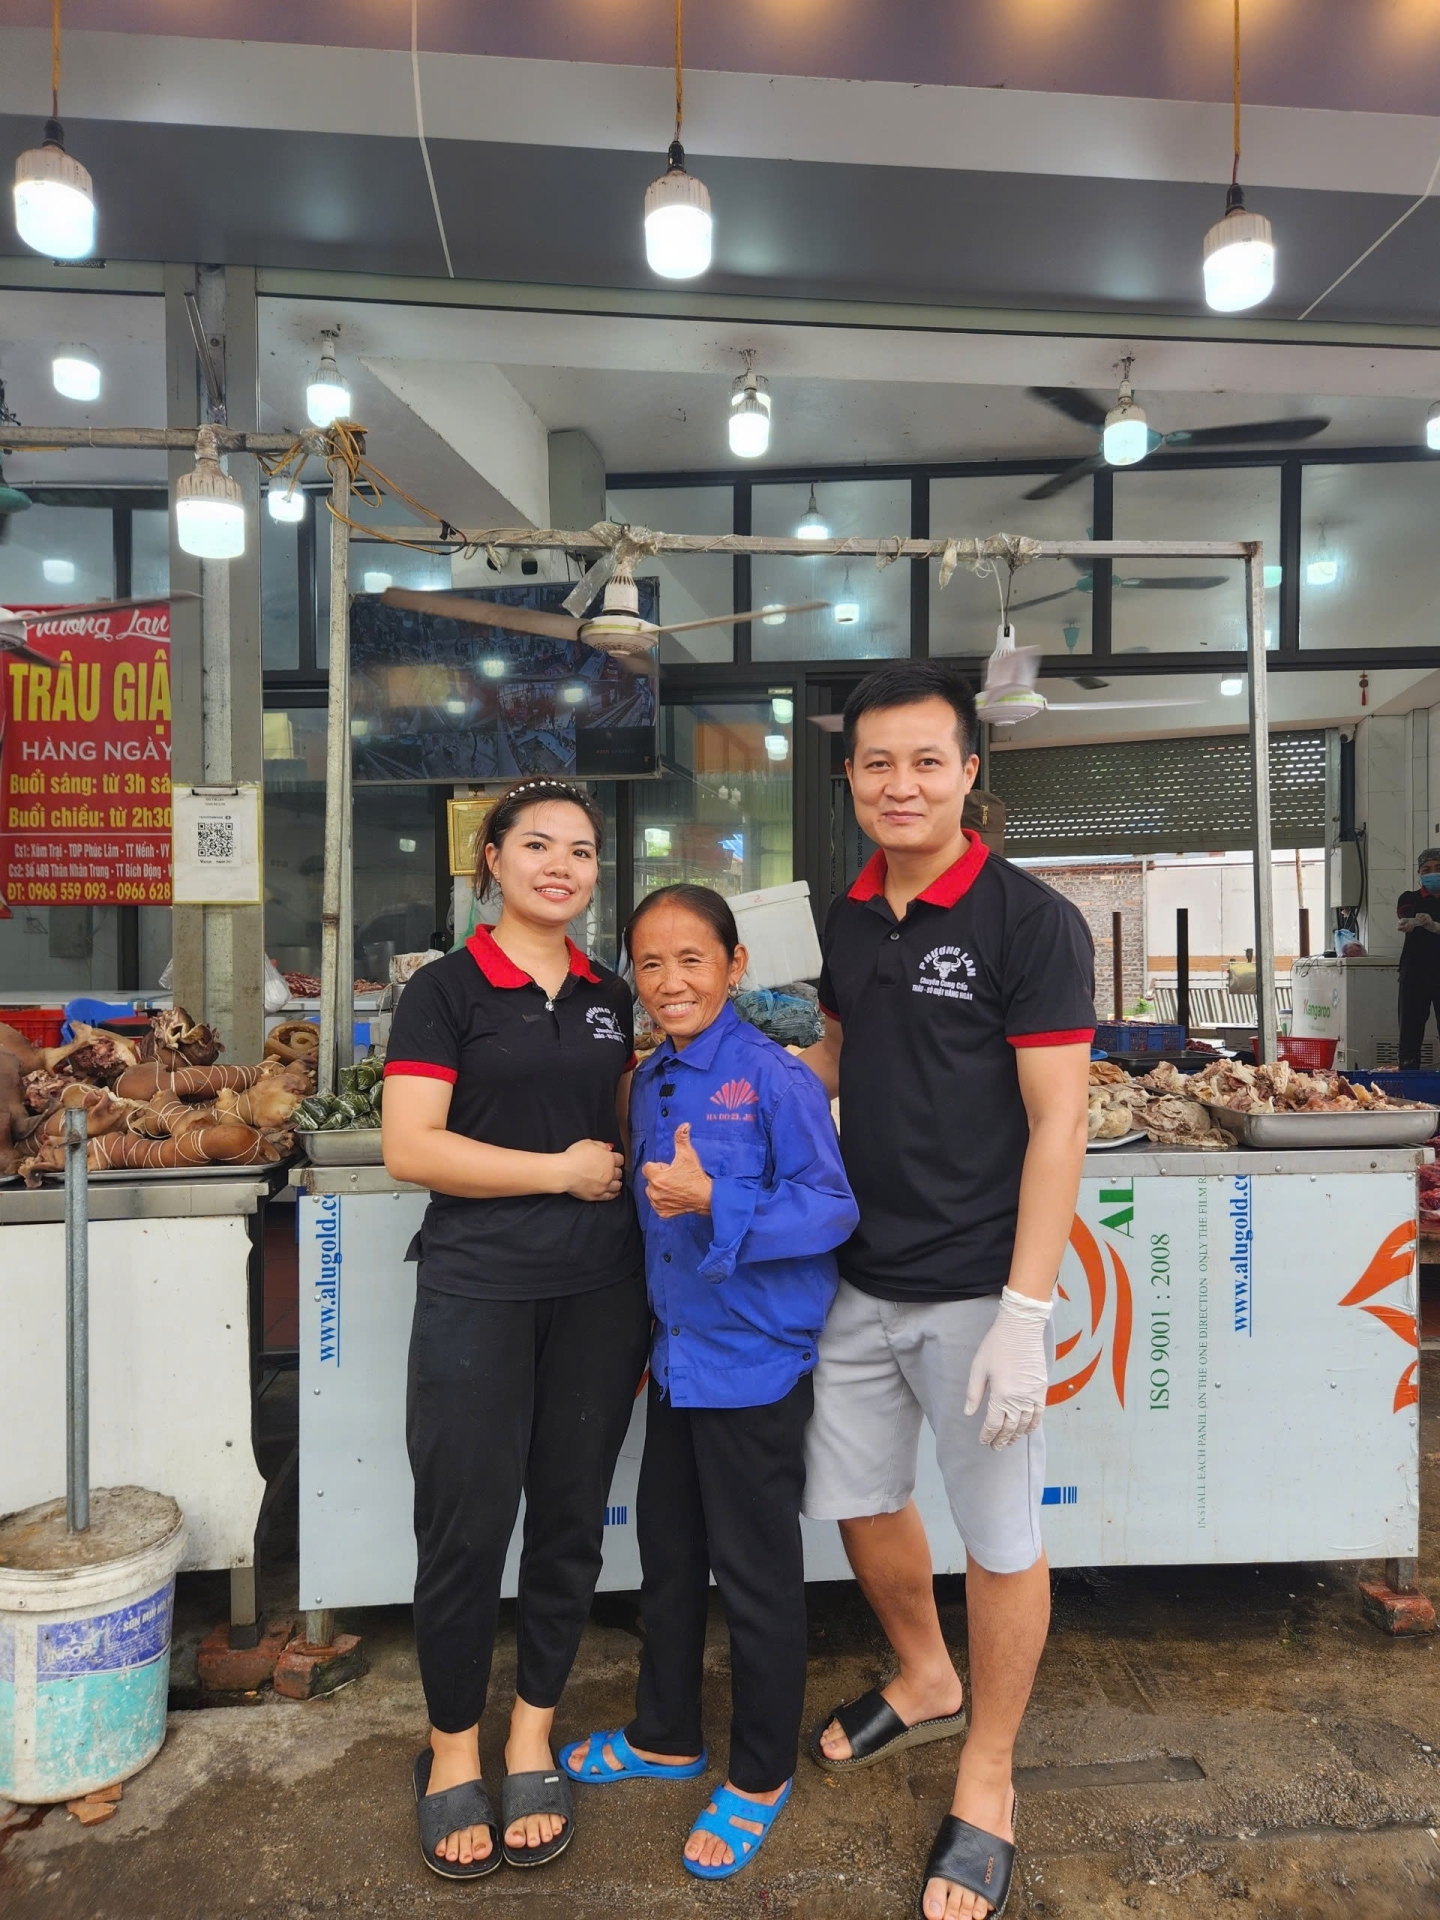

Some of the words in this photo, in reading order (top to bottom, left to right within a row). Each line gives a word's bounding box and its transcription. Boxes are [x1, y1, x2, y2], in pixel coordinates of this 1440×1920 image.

[116, 609, 171, 642] Lan
[9, 650, 101, 722] TRÂU
[22, 737, 97, 761] HÀNG
[104, 737, 172, 761] NGÀY
[9, 768, 46, 794] Buổi
[50, 772, 97, 796] sáng:
[102, 773, 121, 794] từ
[124, 773, 146, 794] 3h
[8, 802, 46, 828] Buổi
[51, 803, 105, 828] chiều:
[109, 806, 127, 828] từ
[48, 843, 63, 861] Trại
[83, 843, 103, 858] Phúc
[103, 843, 119, 858] Lâm
[125, 843, 135, 858] TT
[25, 861, 36, 878] Số
[89, 863, 109, 879] Trung
[115, 863, 124, 878] TT
[125, 863, 142, 878] Bích
[143, 862, 161, 880] Động
[7, 882, 25, 900] ĐT:
[28, 882, 57, 900] 0968
[60, 882, 82, 900] 559
[84, 882, 107, 900] 093
[117, 882, 146, 900] 0966
[149, 882, 171, 900] 628
[918, 945, 961, 970] PHƯƠNG
[960, 952, 977, 977] LAN
[1303, 998, 1331, 1020] Kangaroo
[1199, 1187, 1207, 1214] FILM
[1199, 1217, 1208, 1239] THE
[1150, 1233, 1170, 1287] 2008
[1199, 1241, 1208, 1272] ONLY
[1199, 1278, 1208, 1339] DIRECTION
[1150, 1311, 1170, 1361] 9001
[1199, 1341, 1208, 1365] ONE
[1150, 1368, 1170, 1410] ISO
[1198, 1367, 1207, 1390] THE
[1198, 1391, 1207, 1409] ON
[1197, 1411, 1206, 1446] PANEL
[1197, 1448, 1206, 1480] EACH
